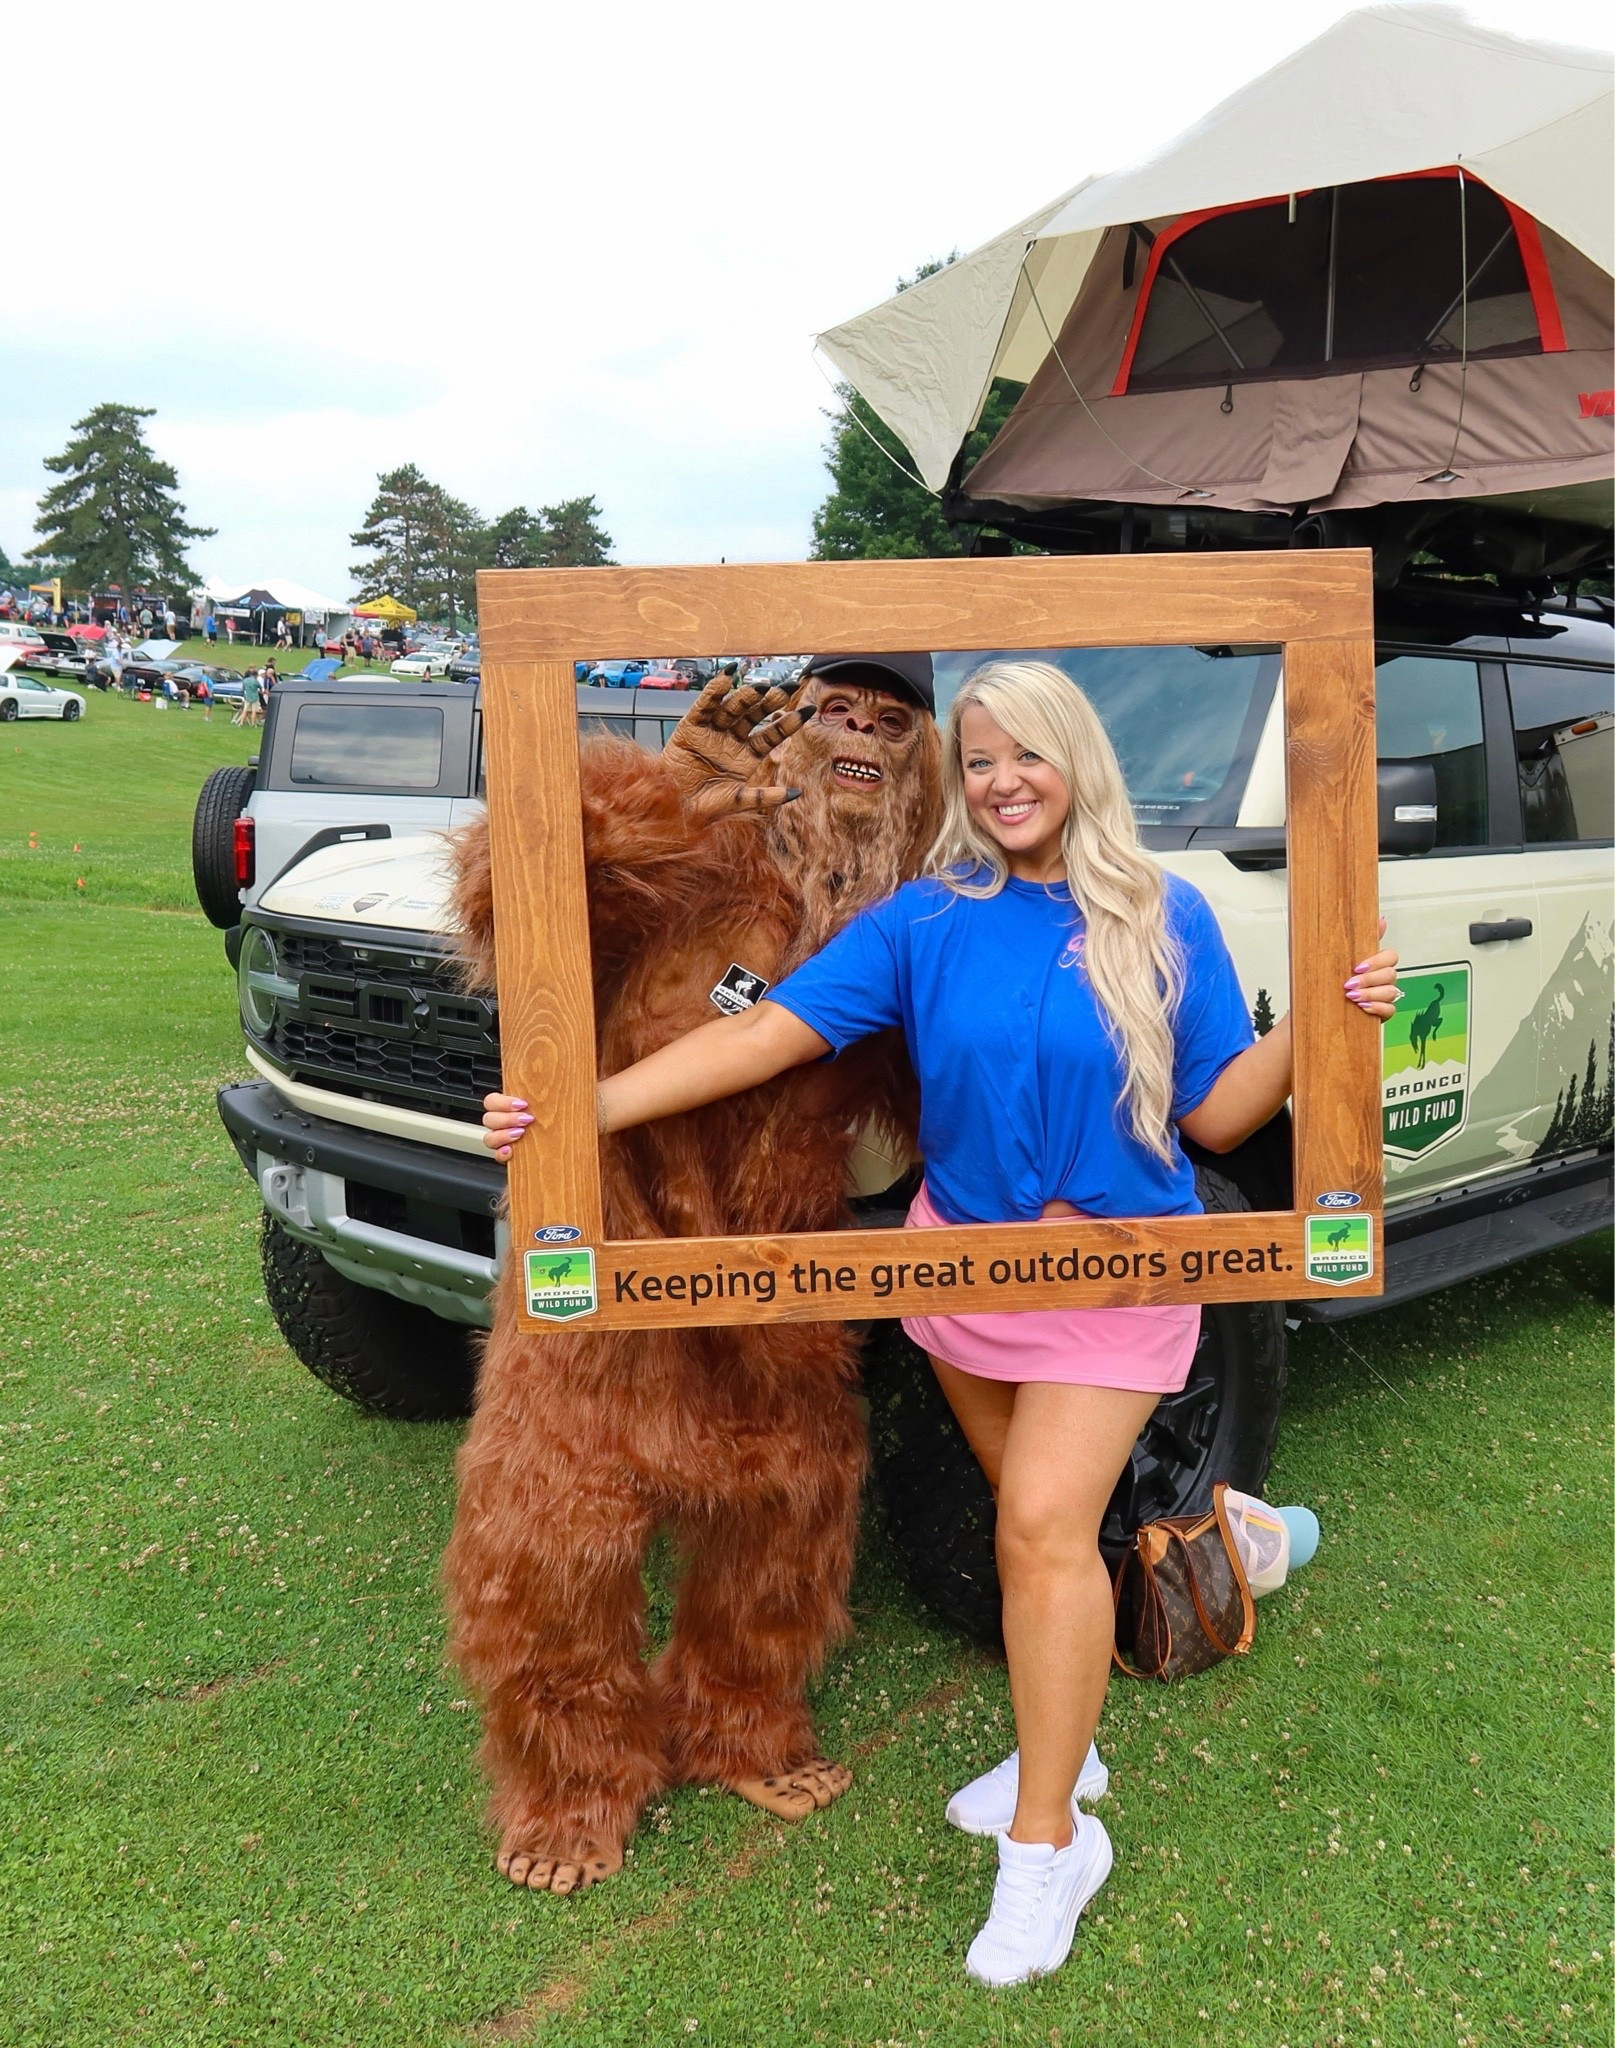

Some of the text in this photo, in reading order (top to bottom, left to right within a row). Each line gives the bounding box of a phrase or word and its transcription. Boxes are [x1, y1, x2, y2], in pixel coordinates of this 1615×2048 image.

[299, 971, 500, 1055] FOR
[1386, 1073, 1462, 1099] BRONCO
[1389, 1099, 1456, 1131] WILD FUND
[1322, 1192, 1354, 1206] Ford
[541, 1227, 574, 1241] Ford
[1313, 1254, 1366, 1262] BRONCO
[614, 1242, 1293, 1306] Keeping the great outdoors great.
[1315, 1263, 1363, 1273] WILD FUND
[534, 1289, 590, 1297] BRONCO
[537, 1298, 588, 1309] WILD FUND
